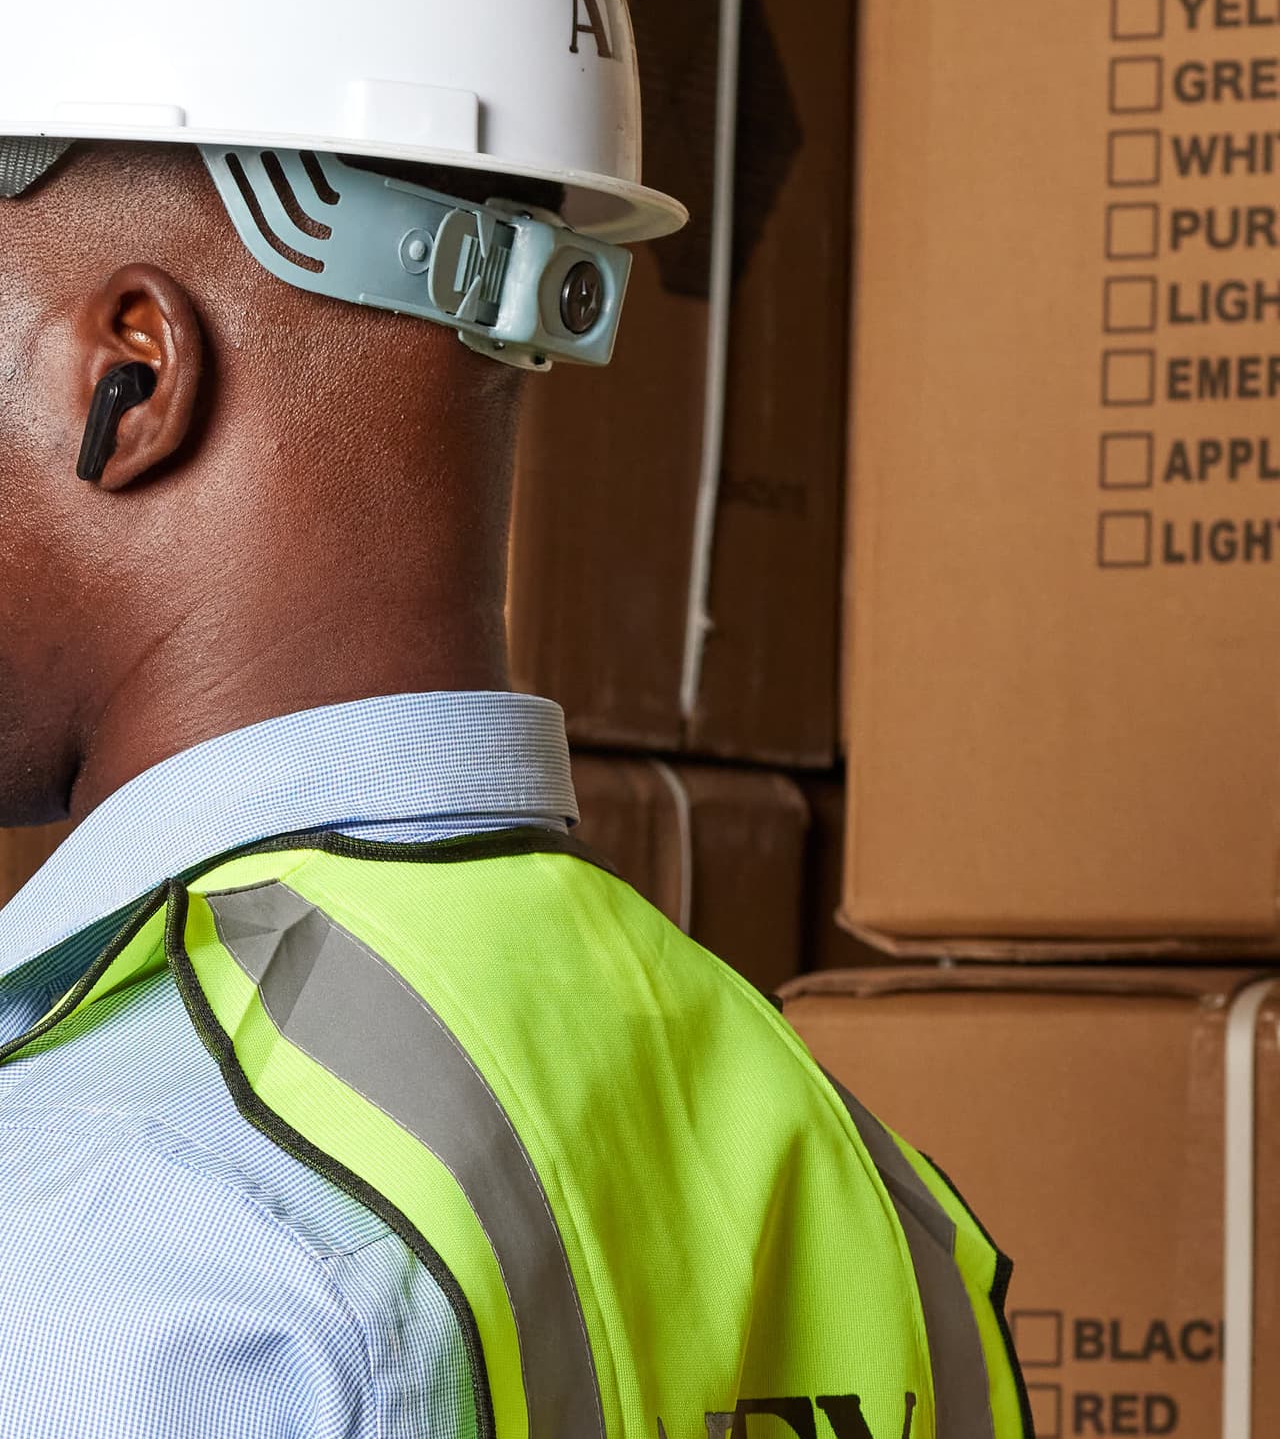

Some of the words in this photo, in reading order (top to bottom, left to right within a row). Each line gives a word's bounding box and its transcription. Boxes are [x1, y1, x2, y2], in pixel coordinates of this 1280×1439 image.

[1162, 517, 1280, 565] LIGH
[1072, 1319, 1225, 1363] BLAC
[1072, 1393, 1179, 1437] RED
